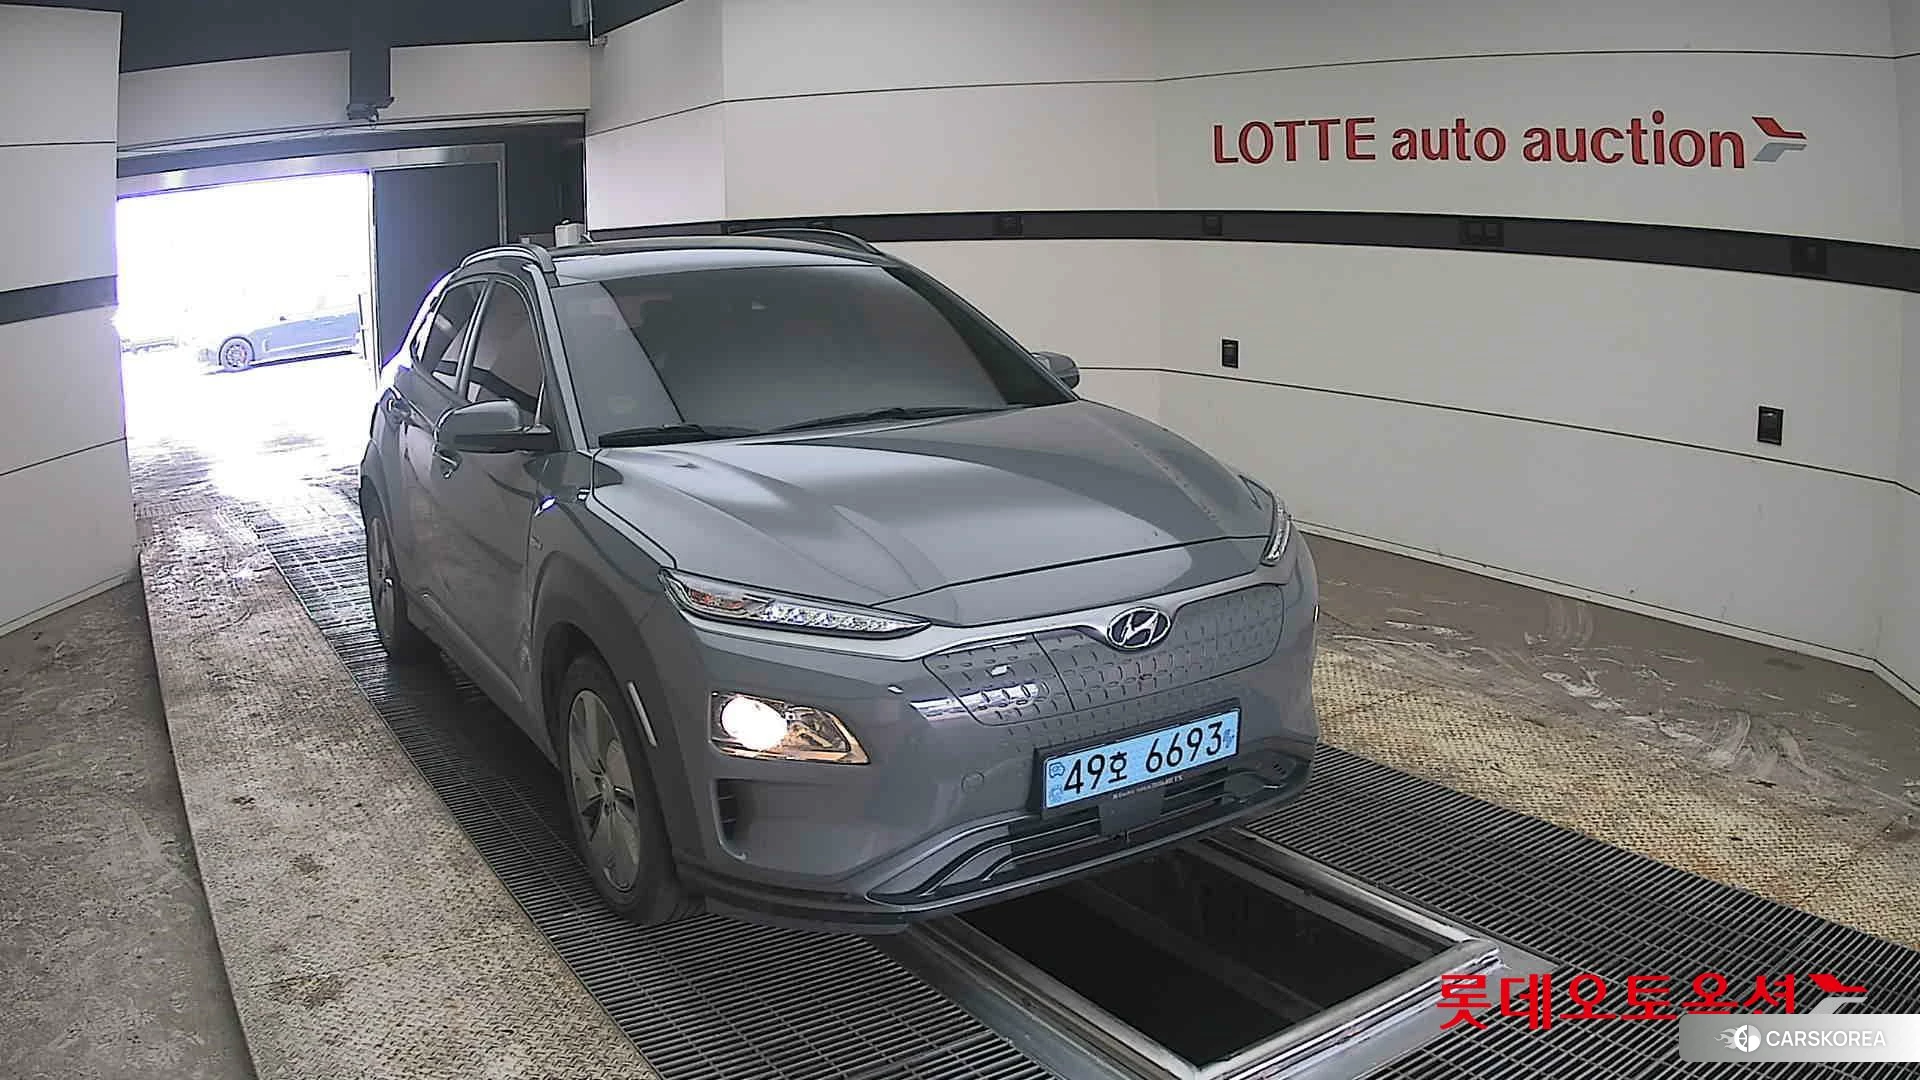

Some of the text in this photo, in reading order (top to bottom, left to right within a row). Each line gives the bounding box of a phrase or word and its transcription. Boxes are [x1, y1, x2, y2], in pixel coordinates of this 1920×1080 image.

[1212, 110, 1746, 168] LOTTE auto auction
[1063, 751, 1128, 794] 49호
[1145, 721, 1223, 773] 6693
